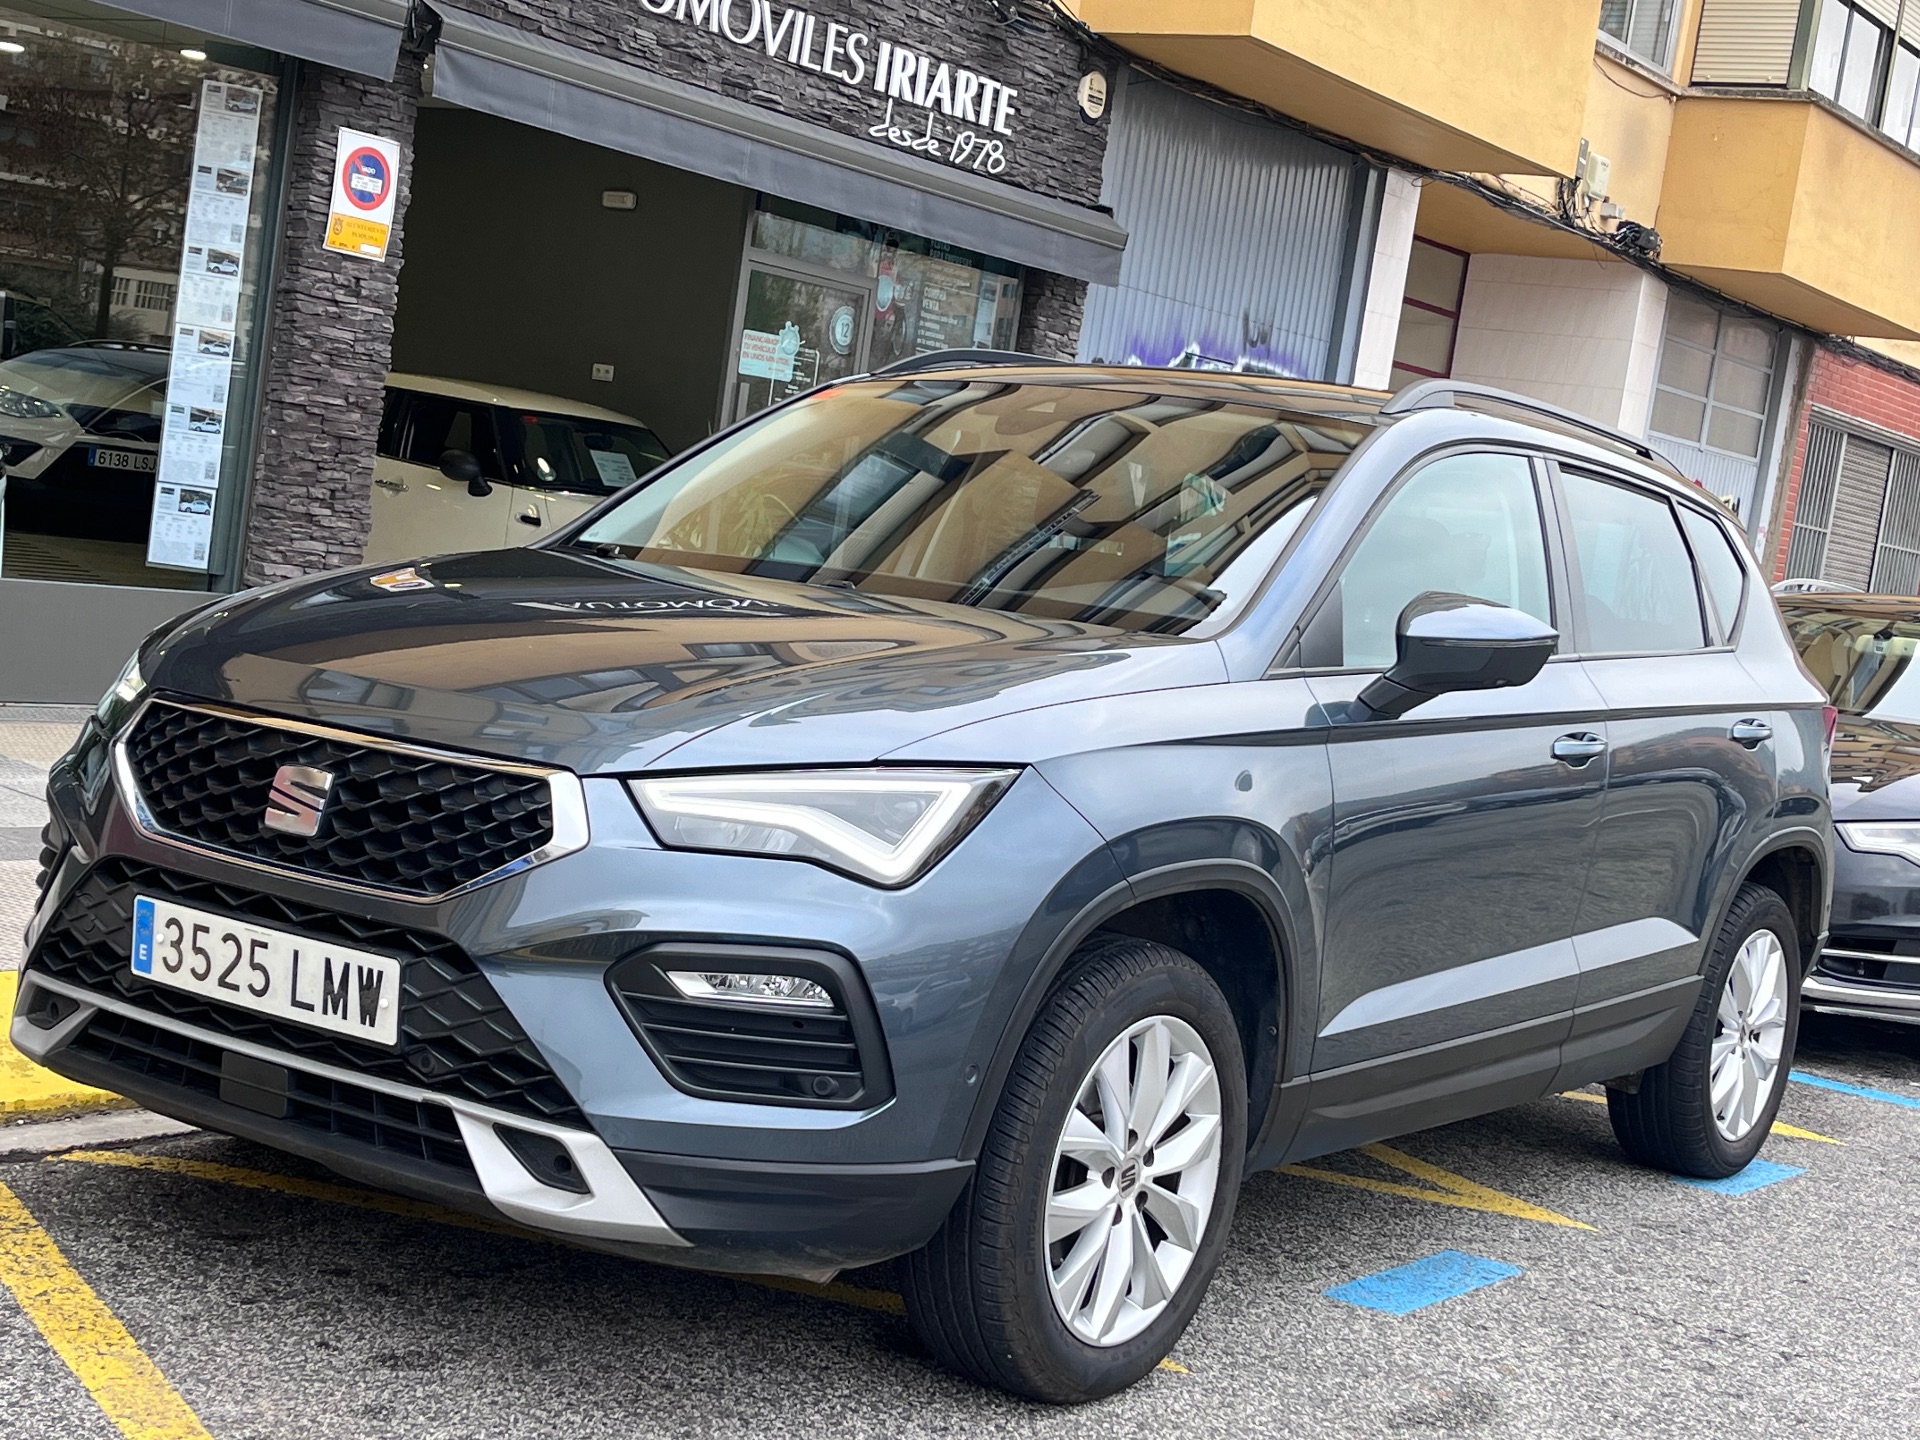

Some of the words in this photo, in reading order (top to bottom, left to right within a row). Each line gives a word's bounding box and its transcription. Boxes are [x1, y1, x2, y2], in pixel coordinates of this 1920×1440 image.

[873, 41, 1018, 136] IRIARTE
[869, 97, 942, 157] desde
[948, 130, 1007, 174] 1978
[840, 322, 850, 338] 12
[98, 451, 129, 468] 6138
[138, 943, 148, 961] E
[161, 916, 271, 998] 3525
[290, 949, 384, 1028] LMW
